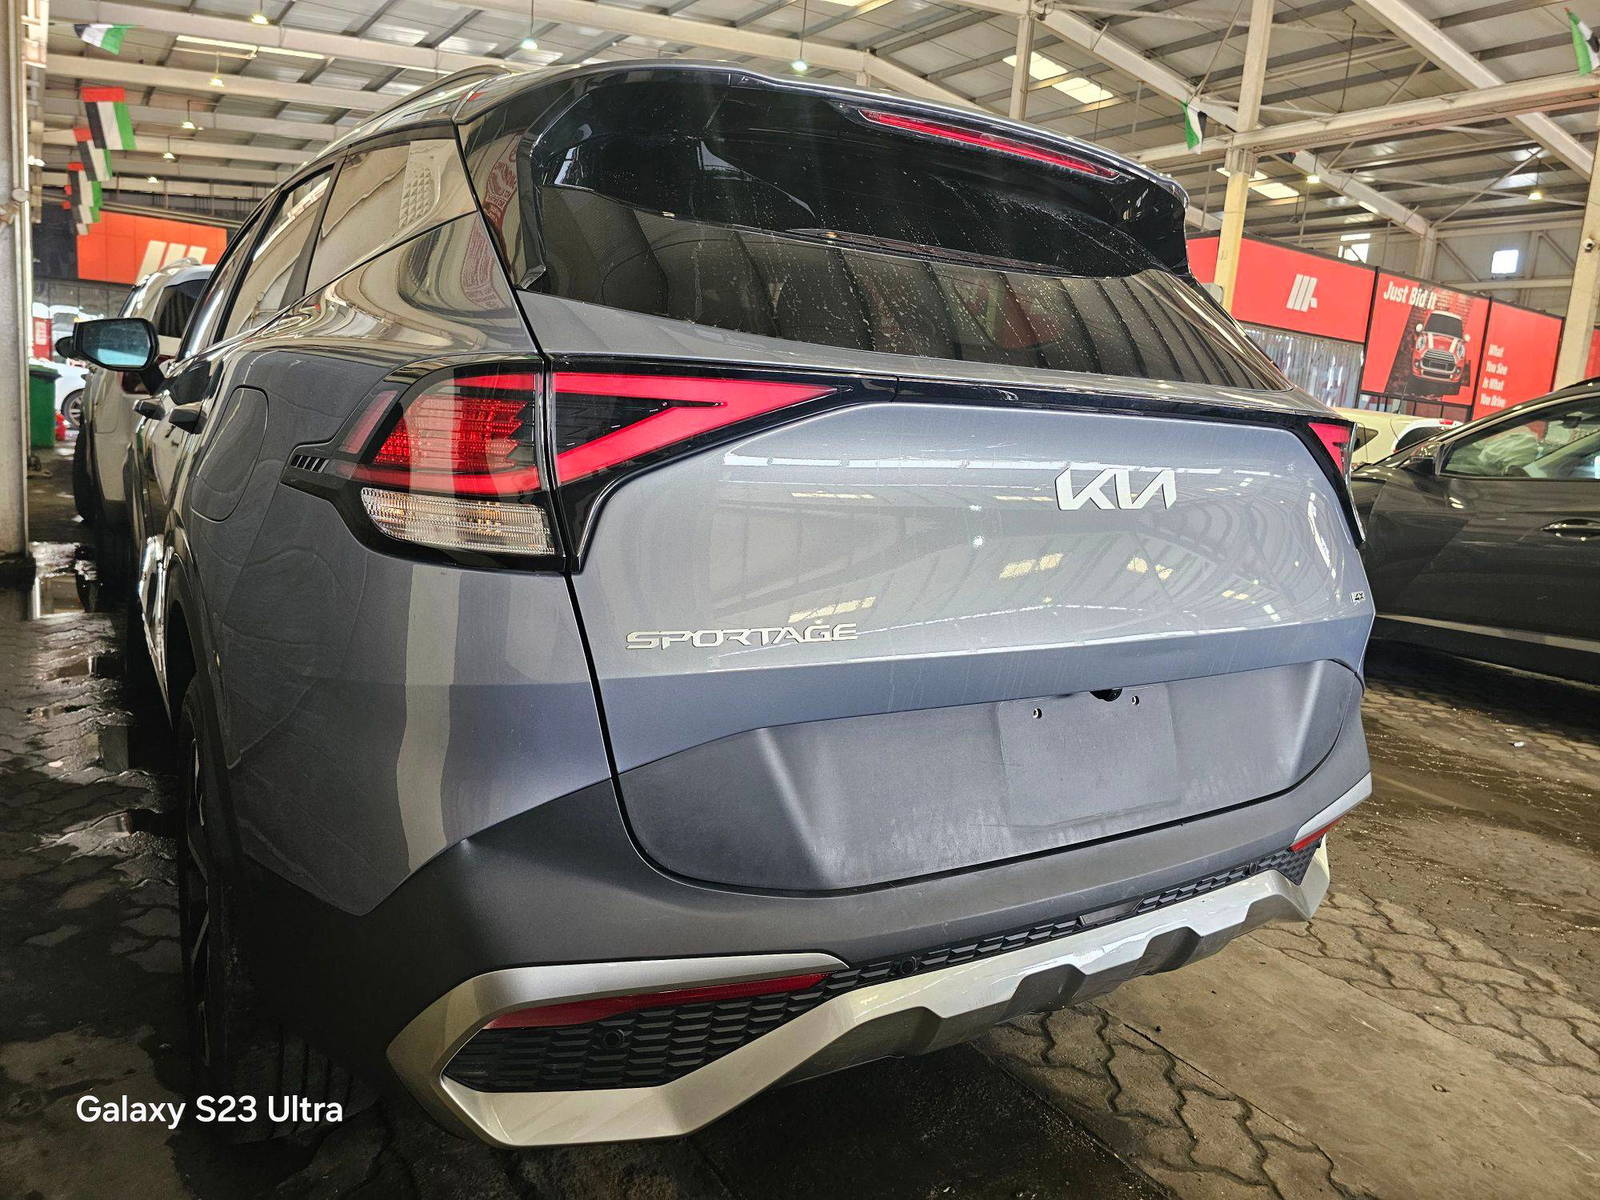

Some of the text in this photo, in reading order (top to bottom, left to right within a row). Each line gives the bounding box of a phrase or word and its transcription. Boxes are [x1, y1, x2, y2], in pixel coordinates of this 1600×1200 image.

[1383, 281, 1438, 310] Just Bid It
[1488, 343, 1504, 358] What
[1485, 360, 1497, 374] You
[1488, 378, 1504, 392] What
[1480, 393, 1491, 406] You
[1055, 467, 1177, 511] KIA
[625, 623, 858, 650] SPORTAGE
